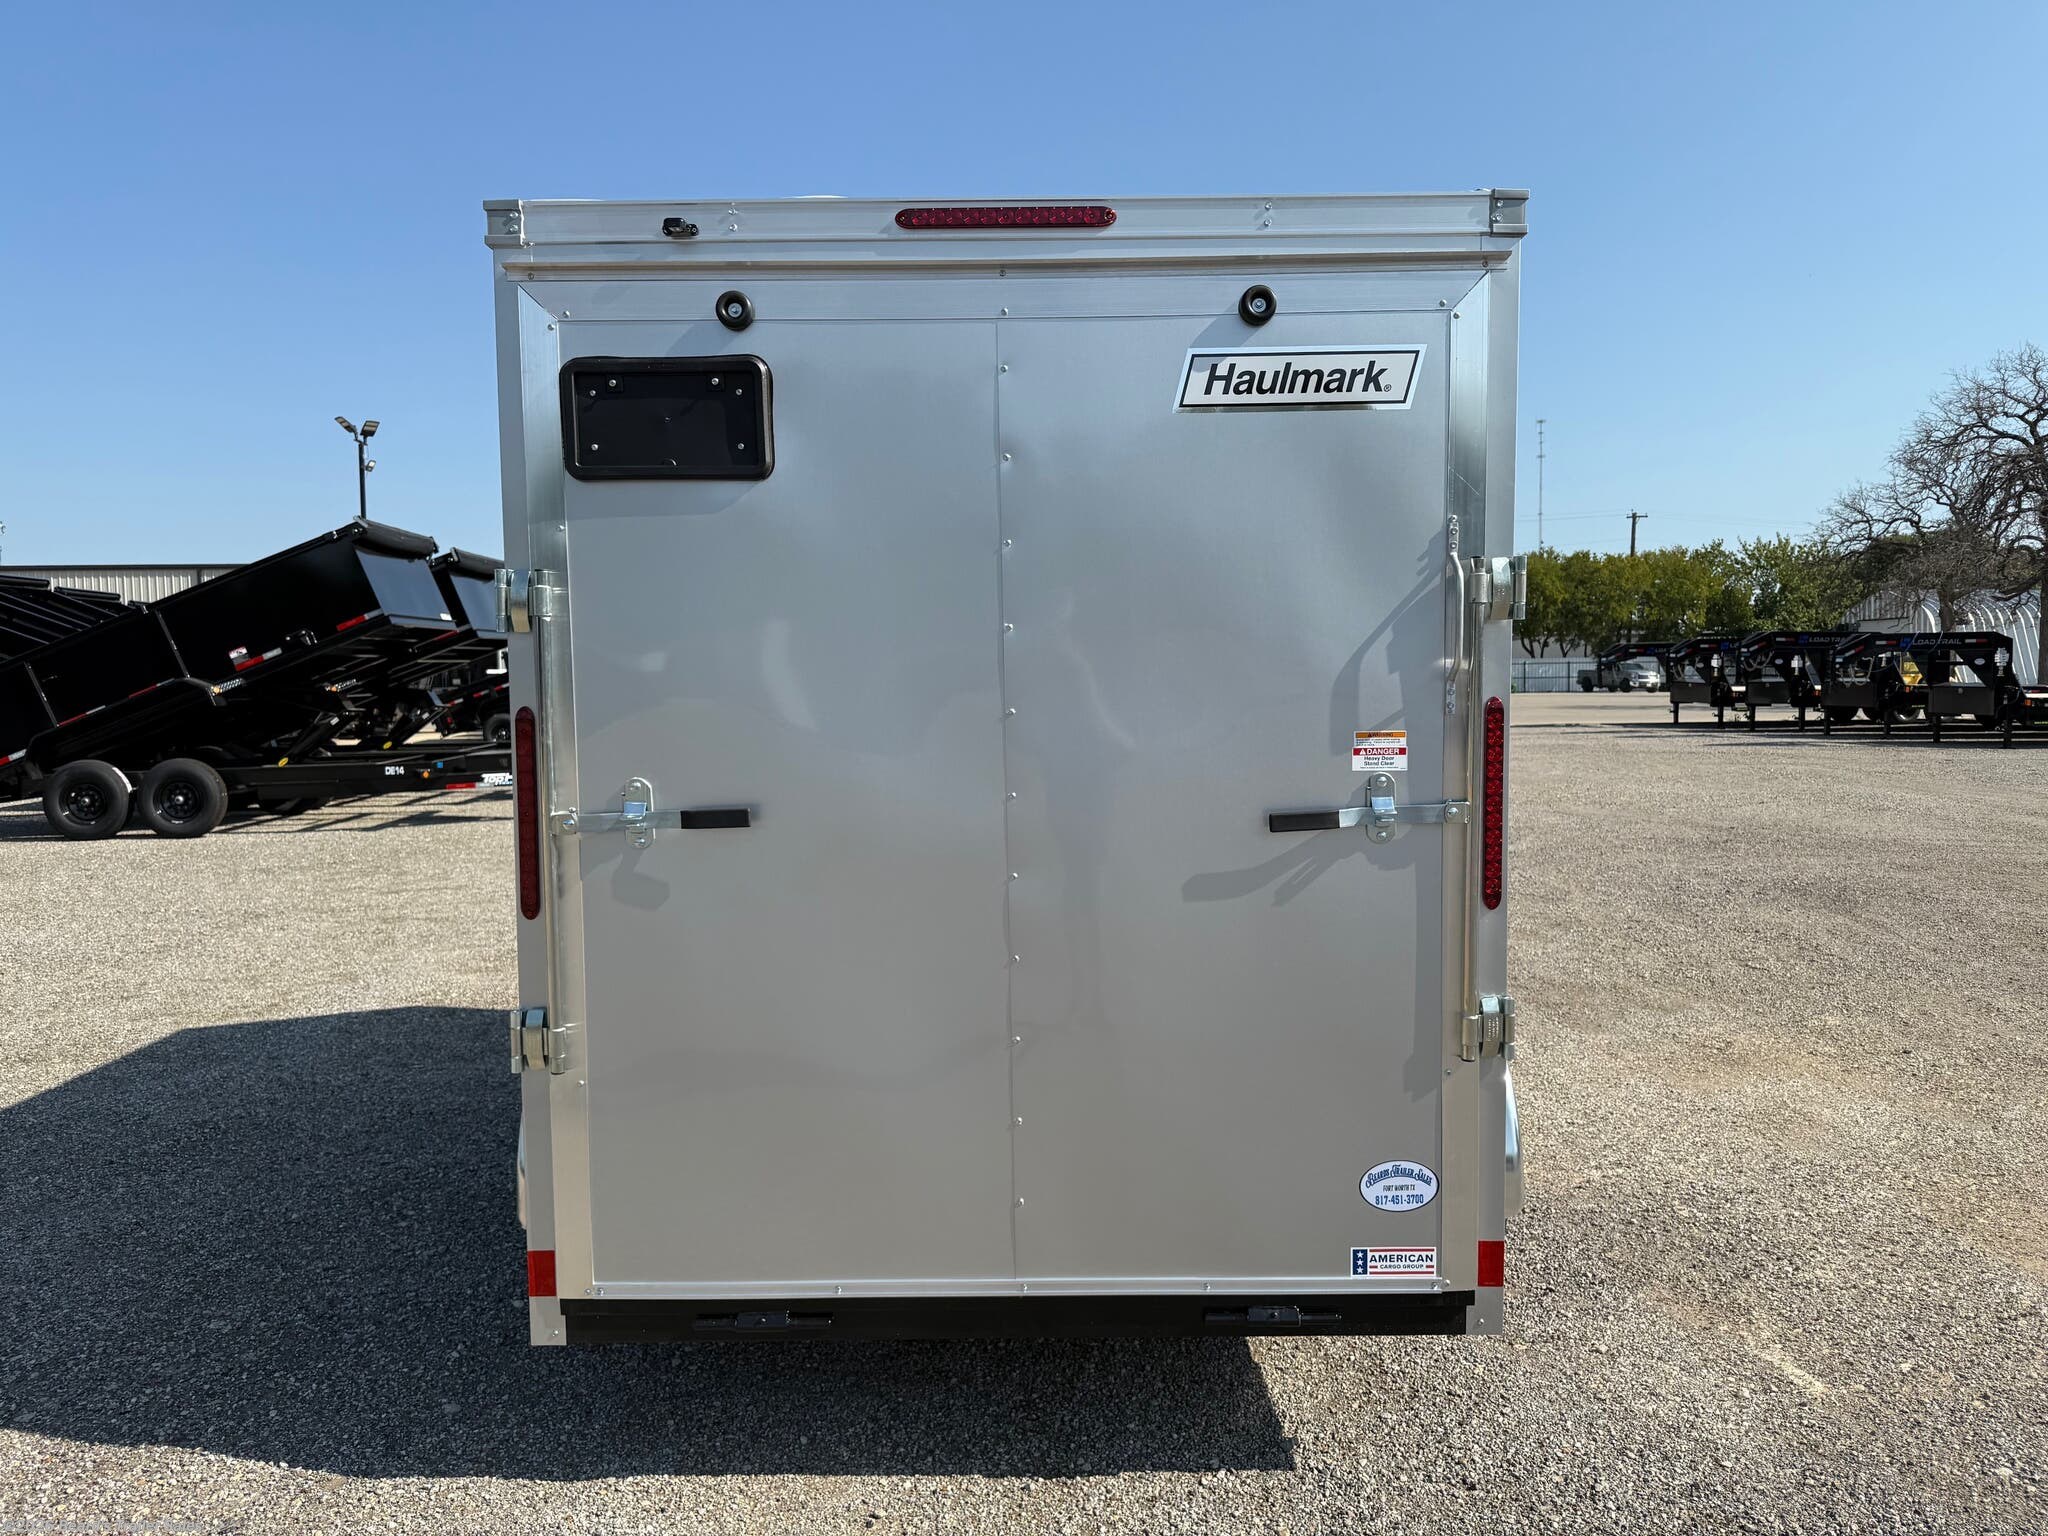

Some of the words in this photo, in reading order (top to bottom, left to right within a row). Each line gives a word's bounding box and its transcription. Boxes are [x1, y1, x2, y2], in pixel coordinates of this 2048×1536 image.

[1203, 360, 1389, 396] Haulmark
[385, 766, 404, 775] DE14
[1375, 1194, 1424, 1205] 817-451-3700
[1369, 1254, 1433, 1263] AMERICAN
